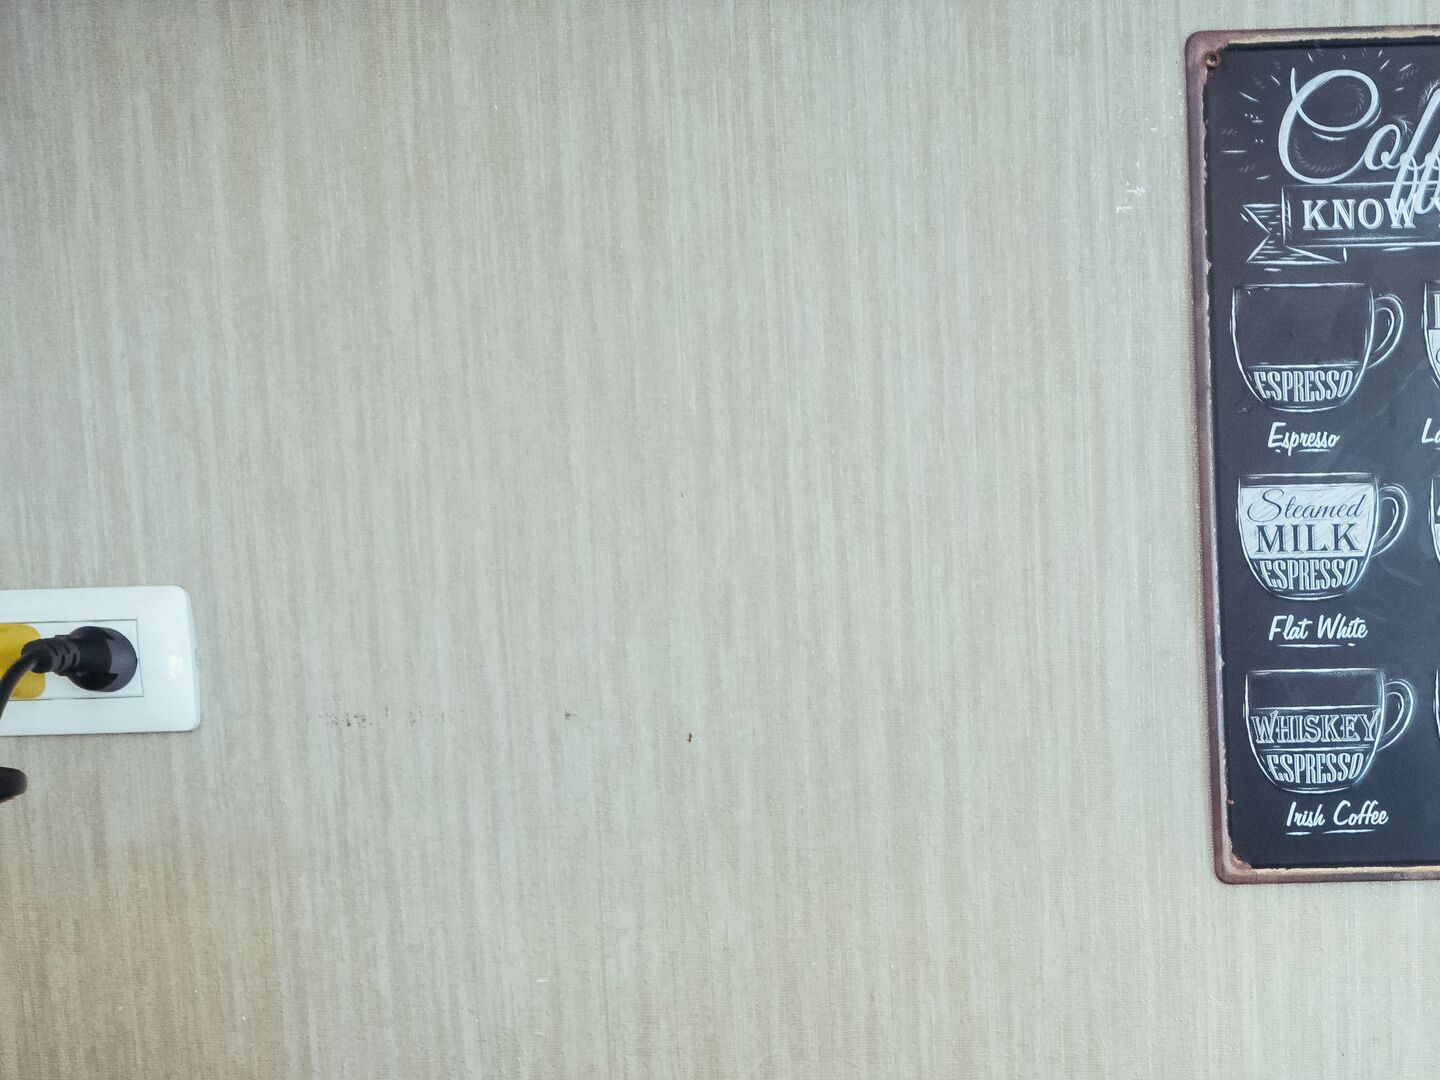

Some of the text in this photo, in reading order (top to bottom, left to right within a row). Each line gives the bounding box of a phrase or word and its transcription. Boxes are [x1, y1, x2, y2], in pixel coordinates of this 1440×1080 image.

[1303, 197, 1418, 231] KNOW
[1254, 369, 1354, 403] ESPRESSO
[1268, 422, 1341, 456] Espresso
[1246, 489, 1364, 521] Steamed
[1256, 523, 1360, 554] MILK
[1260, 558, 1358, 591] ESPRESSO
[1268, 614, 1369, 640] Flat White
[1251, 709, 1380, 744] WHISKEY
[1266, 751, 1364, 784] ESPRESSO
[1286, 800, 1389, 828] Irish Coffee
